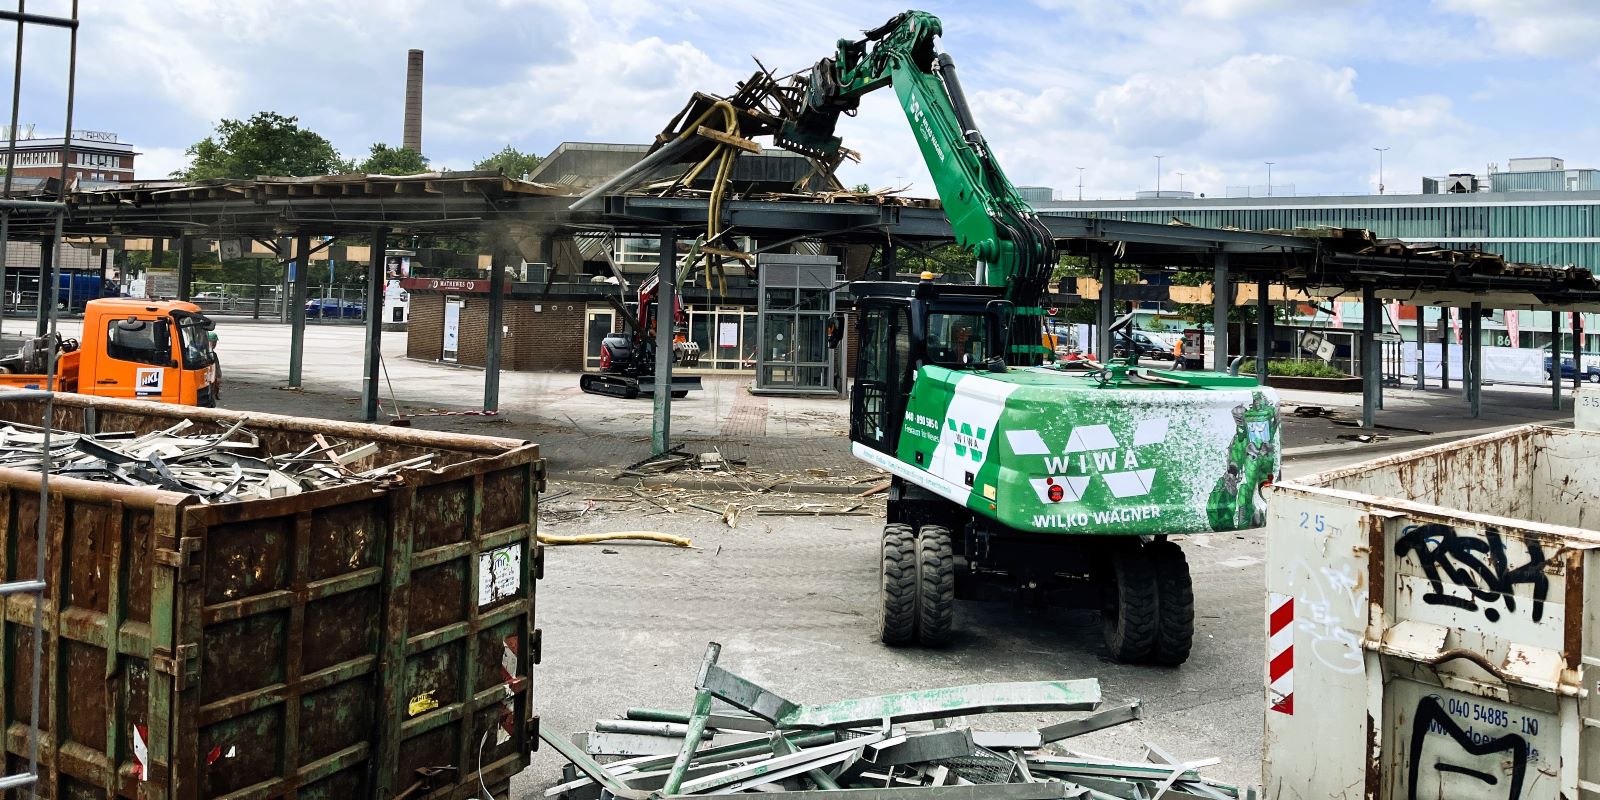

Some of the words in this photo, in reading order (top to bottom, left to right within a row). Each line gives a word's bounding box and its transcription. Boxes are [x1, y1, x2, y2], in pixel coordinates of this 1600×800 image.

[1497, 335, 1511, 346] 86
[141, 371, 159, 386] HKL
[1582, 396, 1600, 407] 35
[956, 433, 979, 449] WIWA
[1044, 449, 1139, 475] WIWA
[1033, 513, 1089, 528] WILKO
[1093, 505, 1160, 525] WAGNER
[1448, 698, 1470, 719] 040
[1473, 704, 1508, 728] 54885
[1521, 716, 1539, 736] 110
